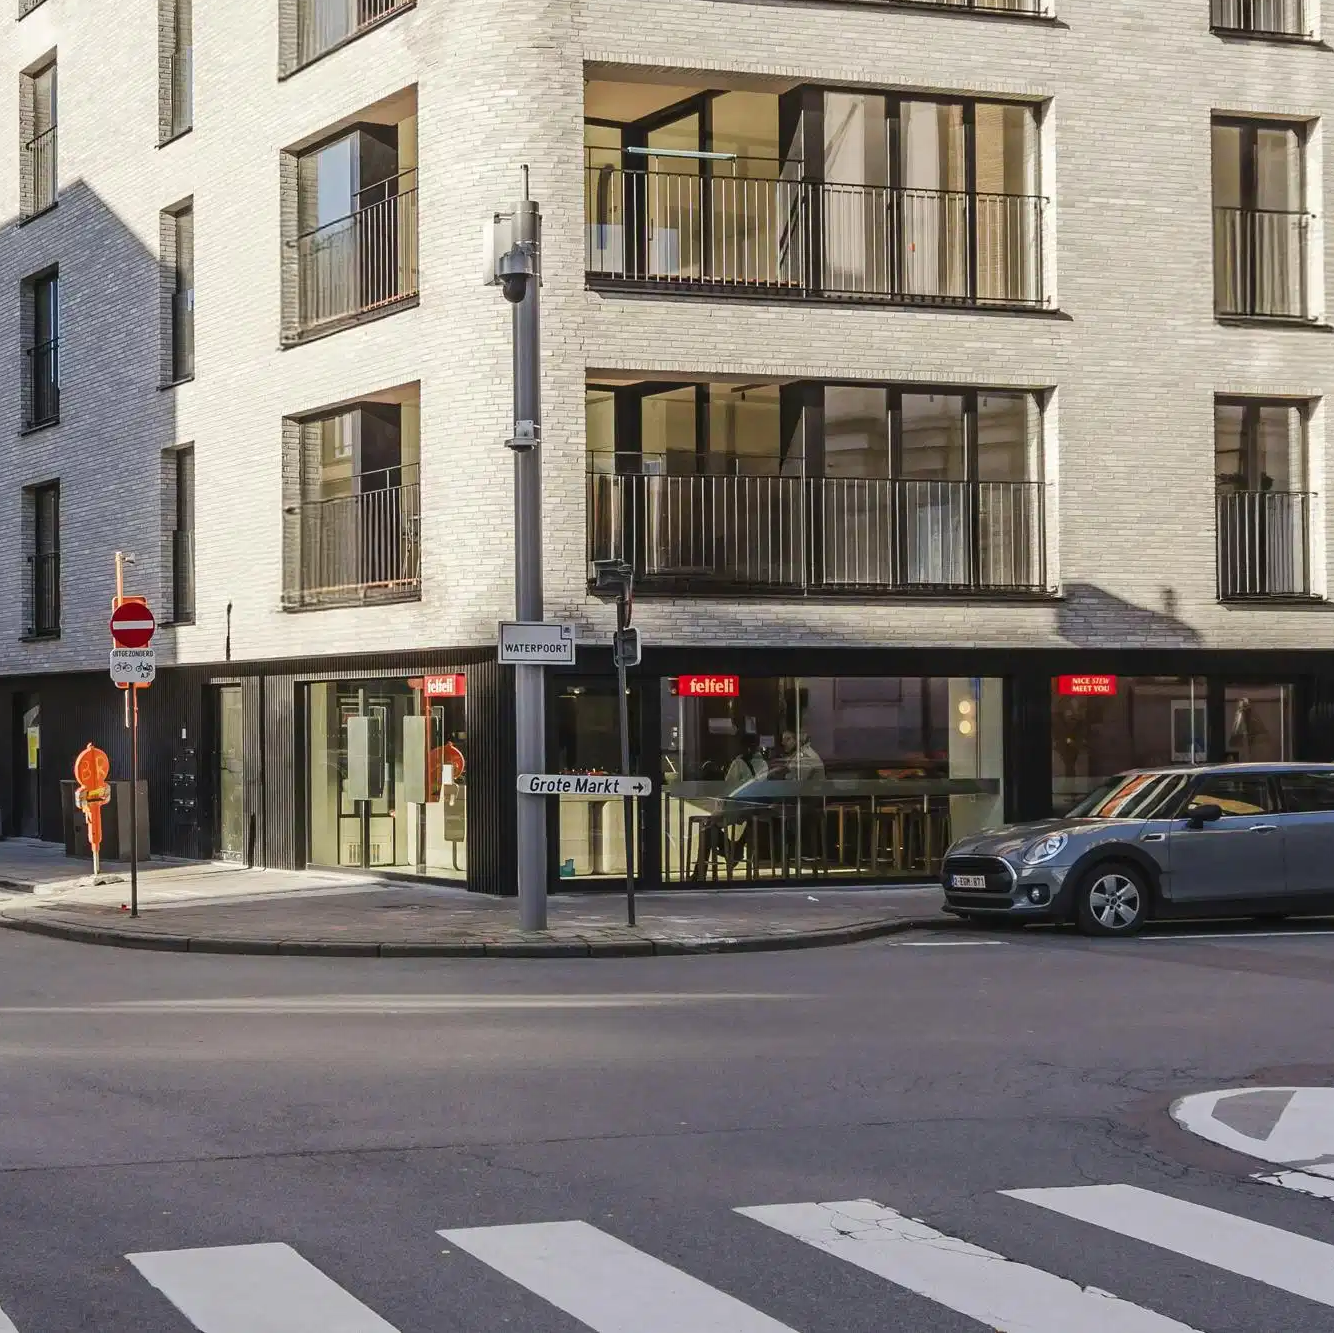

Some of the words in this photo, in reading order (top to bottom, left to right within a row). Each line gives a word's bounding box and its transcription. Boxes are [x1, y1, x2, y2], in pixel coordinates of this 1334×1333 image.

[504, 643, 568, 653] WATERPOORT
[427, 678, 454, 693] felfeli
[689, 678, 735, 693] felfeli
[529, 776, 571, 792] Grote
[574, 778, 621, 794] Markt
